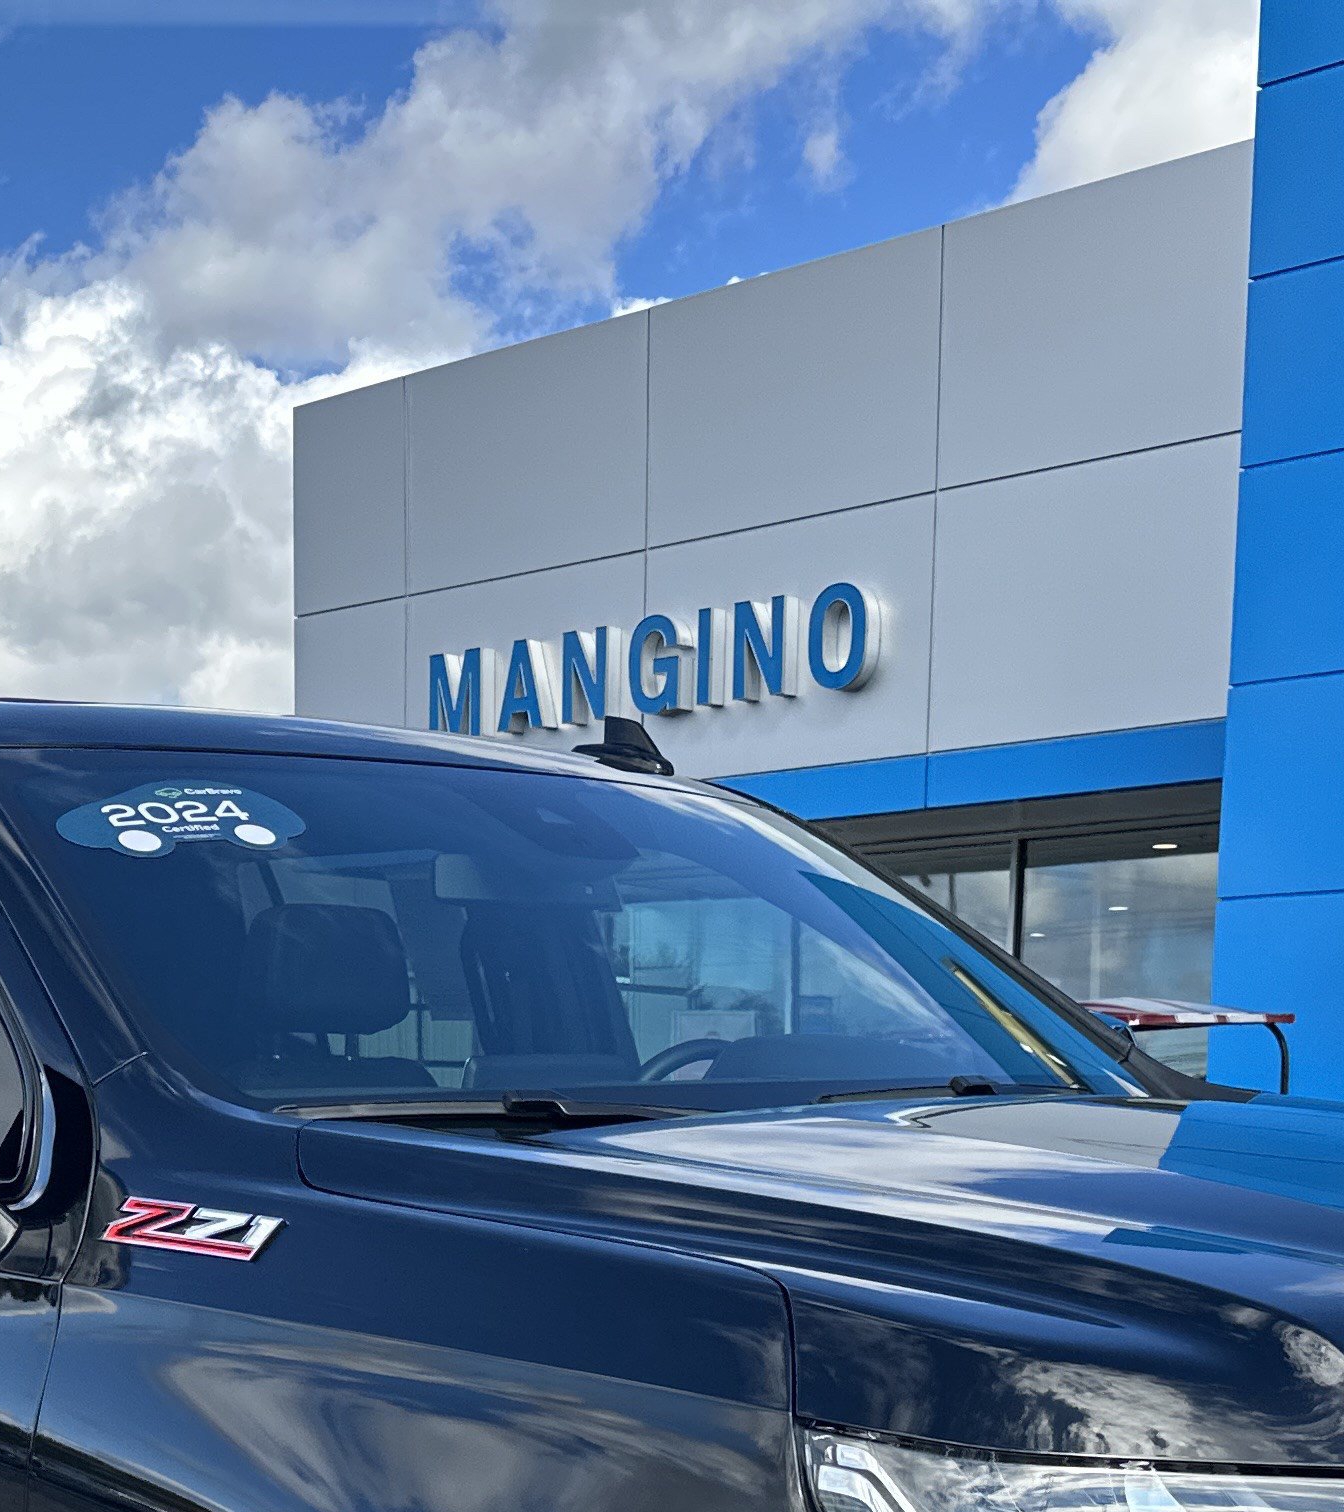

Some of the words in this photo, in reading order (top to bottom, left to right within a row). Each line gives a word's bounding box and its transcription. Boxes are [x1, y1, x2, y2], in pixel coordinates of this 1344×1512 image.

[428, 582, 882, 736] MANGINO
[100, 800, 250, 827] 2024
[161, 823, 220, 833] Certified
[101, 1195, 284, 1262] Z71
